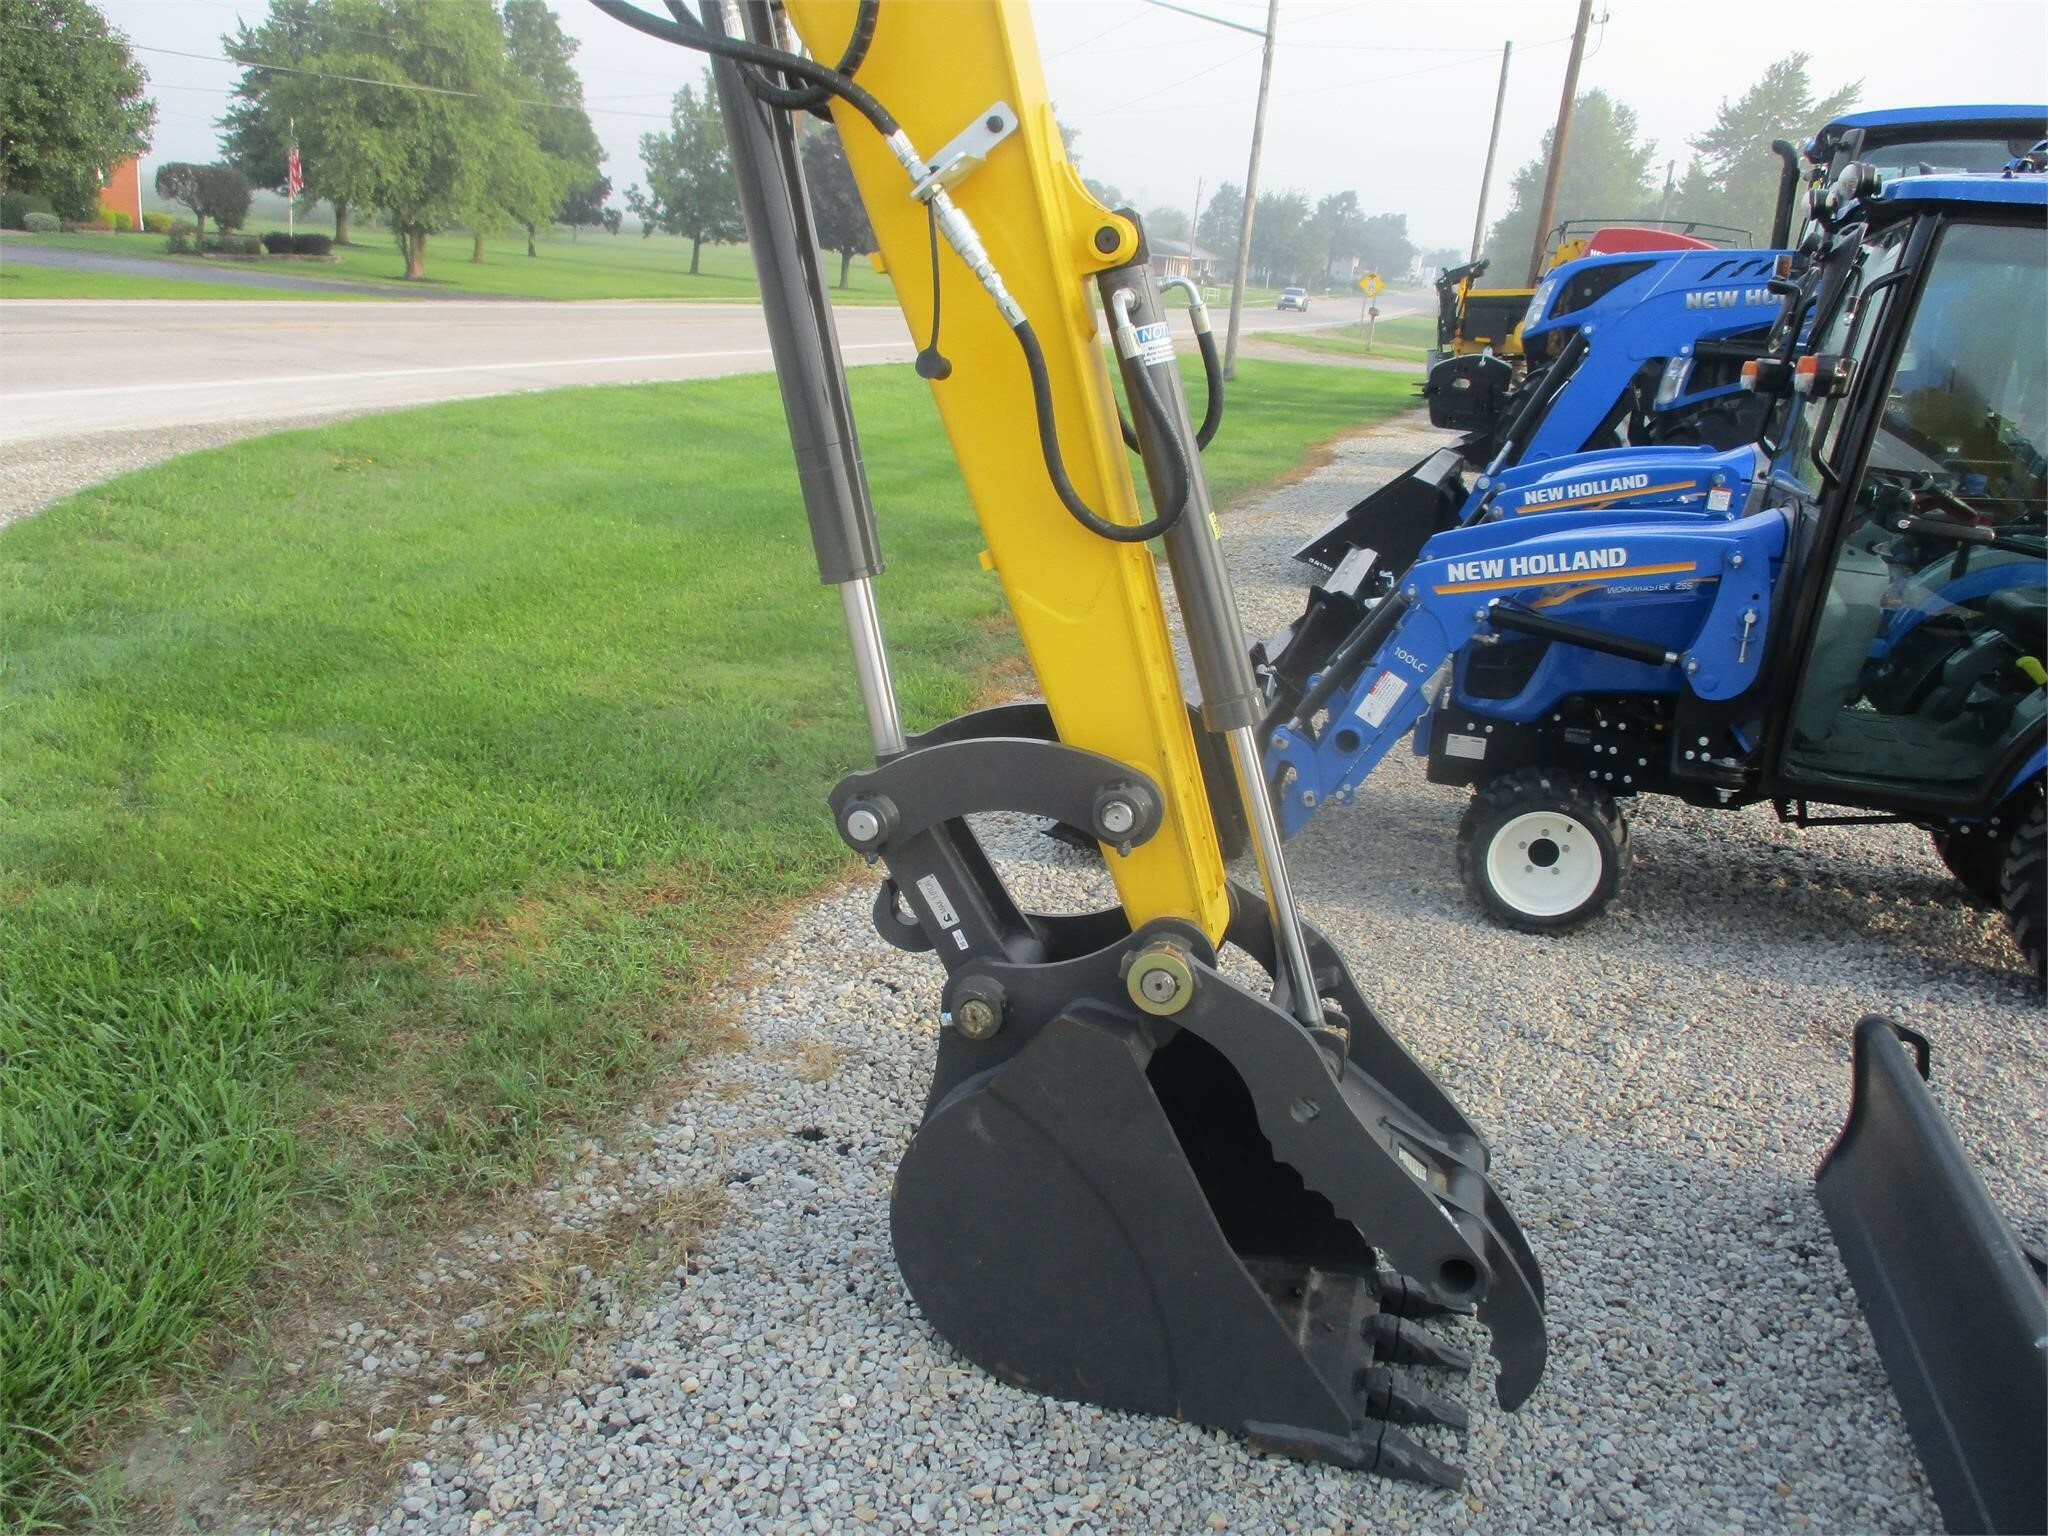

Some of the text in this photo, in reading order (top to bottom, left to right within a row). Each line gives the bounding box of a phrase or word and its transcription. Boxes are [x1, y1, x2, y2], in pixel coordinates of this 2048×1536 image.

[1686, 290, 1739, 309] NEW
[1524, 473, 1648, 505] NEW HOLLAND
[1447, 547, 1627, 583] NEW HOLLAND
[1394, 647, 1428, 673] 100LC
